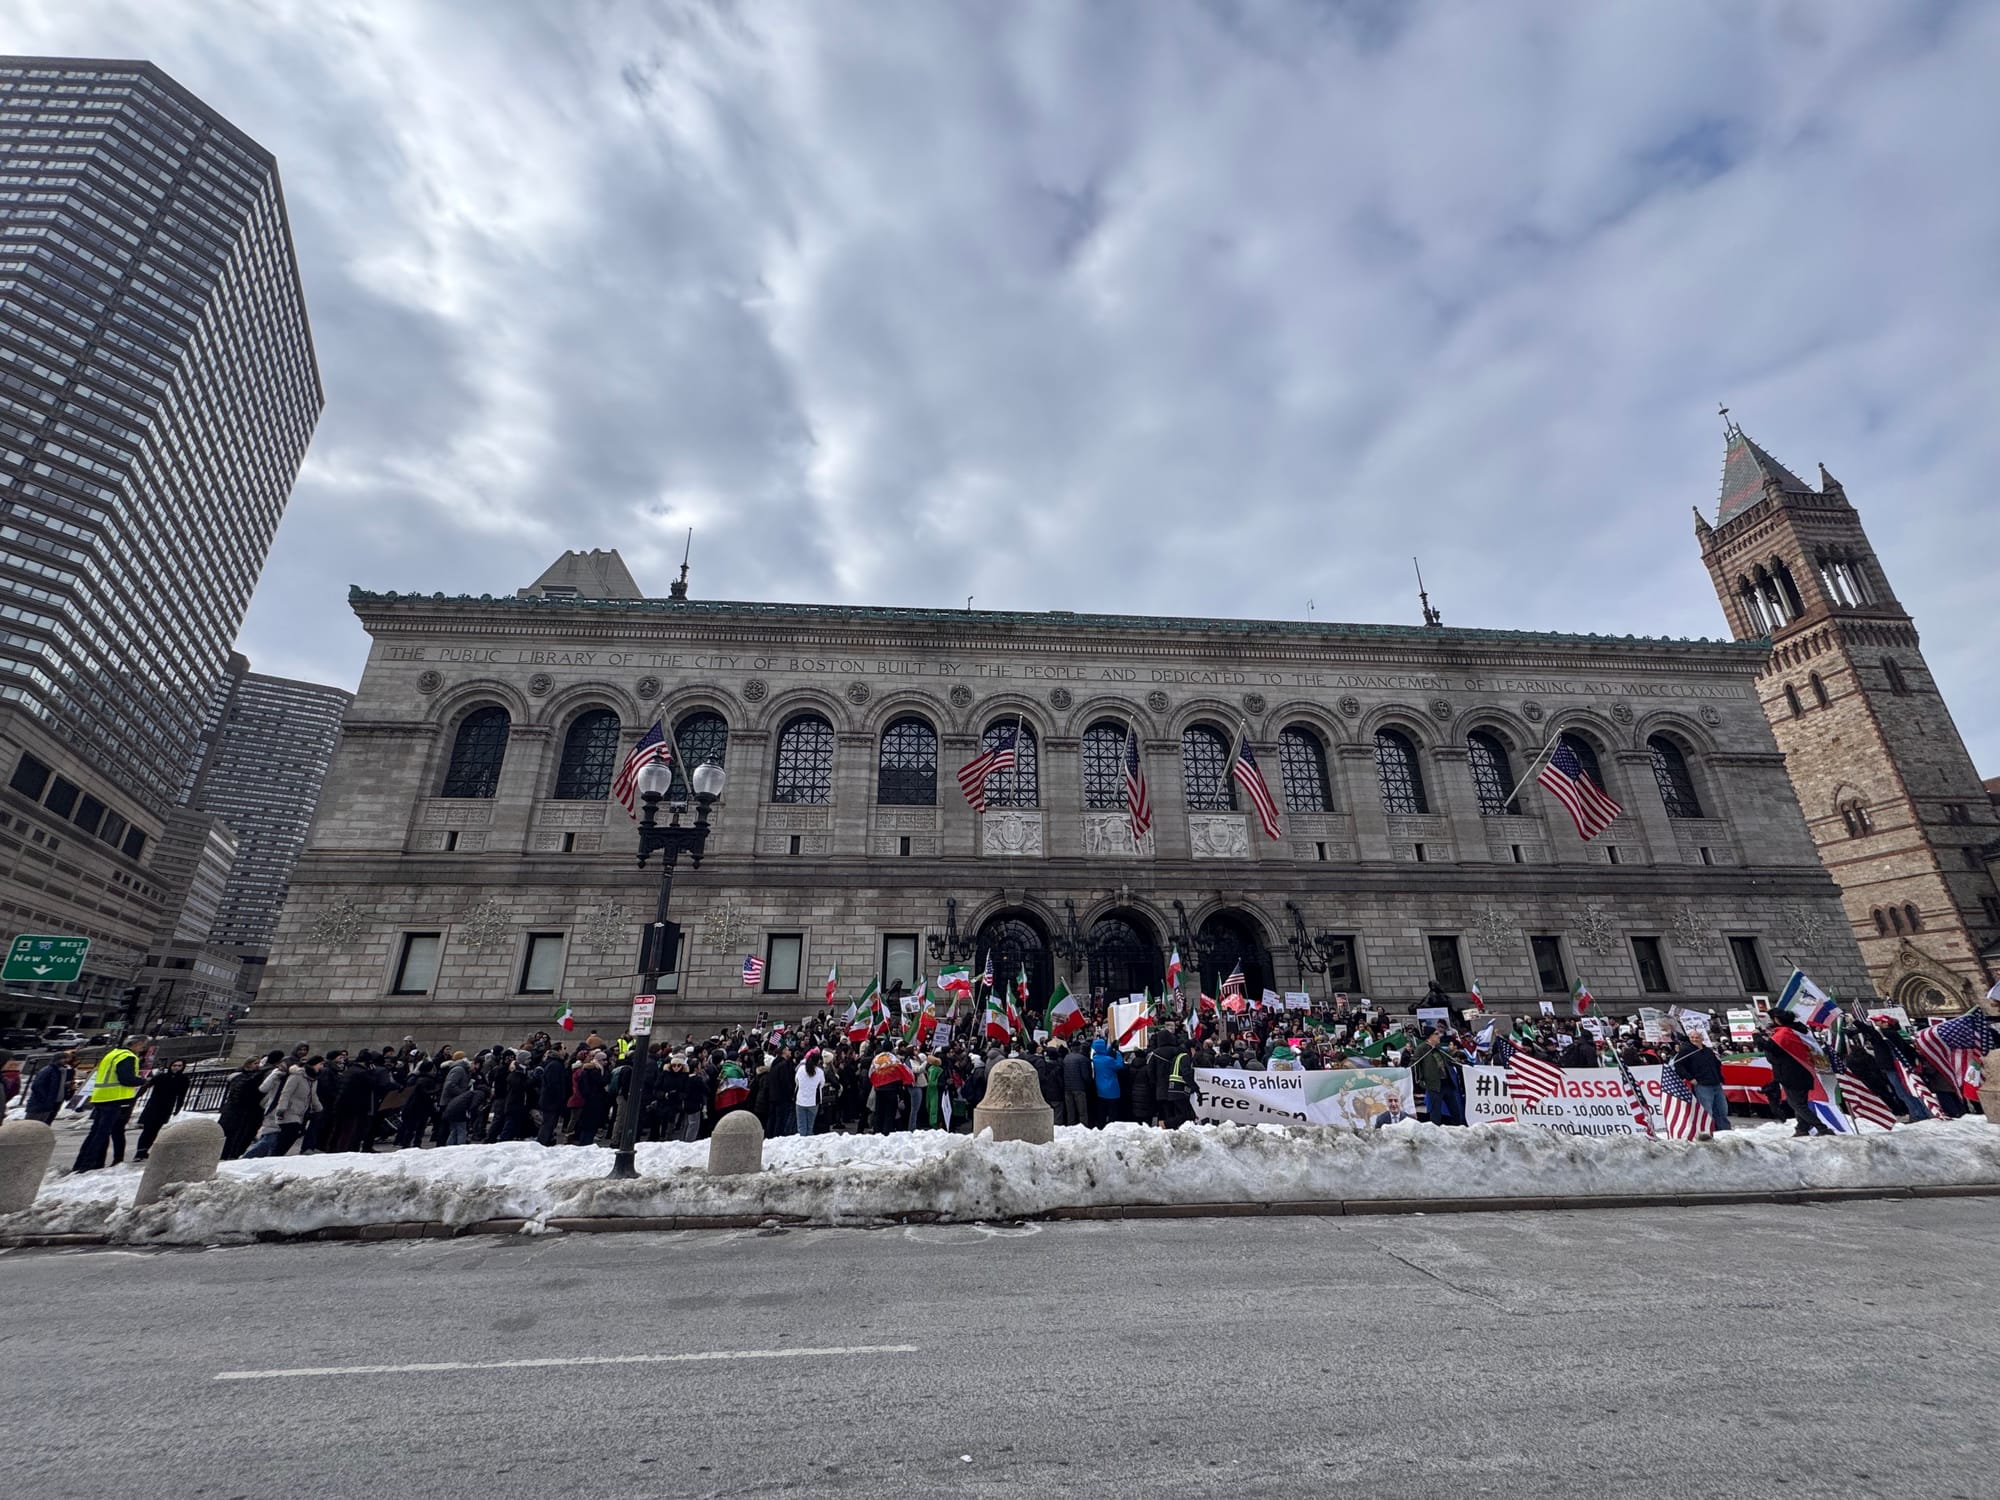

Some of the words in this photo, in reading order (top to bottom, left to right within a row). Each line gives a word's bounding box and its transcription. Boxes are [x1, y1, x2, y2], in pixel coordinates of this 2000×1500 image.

[391, 647, 425, 660] THE
[440, 648, 502, 662] PUBLIC
[518, 650, 598, 665] LIBRARY
[608, 653, 634, 666] OF
[649, 654, 683, 667] THE
[695, 655, 740, 668] CITY
[753, 657, 778, 670] OF
[789, 658, 865, 672] BOSTON
[877, 661, 927, 674] BUILT
[938, 663, 961, 676] BY
[975, 664, 1014, 678] THE
[1024, 666, 1087, 680] PEOPLE
[1100, 668, 1137, 681] AND
[1151, 669, 1246, 684] DEDICATED
[1259, 673, 1282, 685] TO
[1292, 674, 1325, 687] THE
[1336, 675, 1452, 690] ADVANCEMENT
[1464, 679, 1487, 691] OF
[1498, 679, 1576, 694] LEARNING
[13, 953, 42, 962] New
[49, 955, 77, 964] York
[1211, 1075, 1246, 1090] Reza
[1249, 1075, 1302, 1090] Pahlavi
[1198, 1092, 1250, 1110] Free
[1259, 1103, 1307, 1122] Iran
[1475, 1102, 1517, 1116] 43,000
[1521, 1104, 1564, 1117] KILLED
[1573, 1104, 1614, 1118] 10,000
